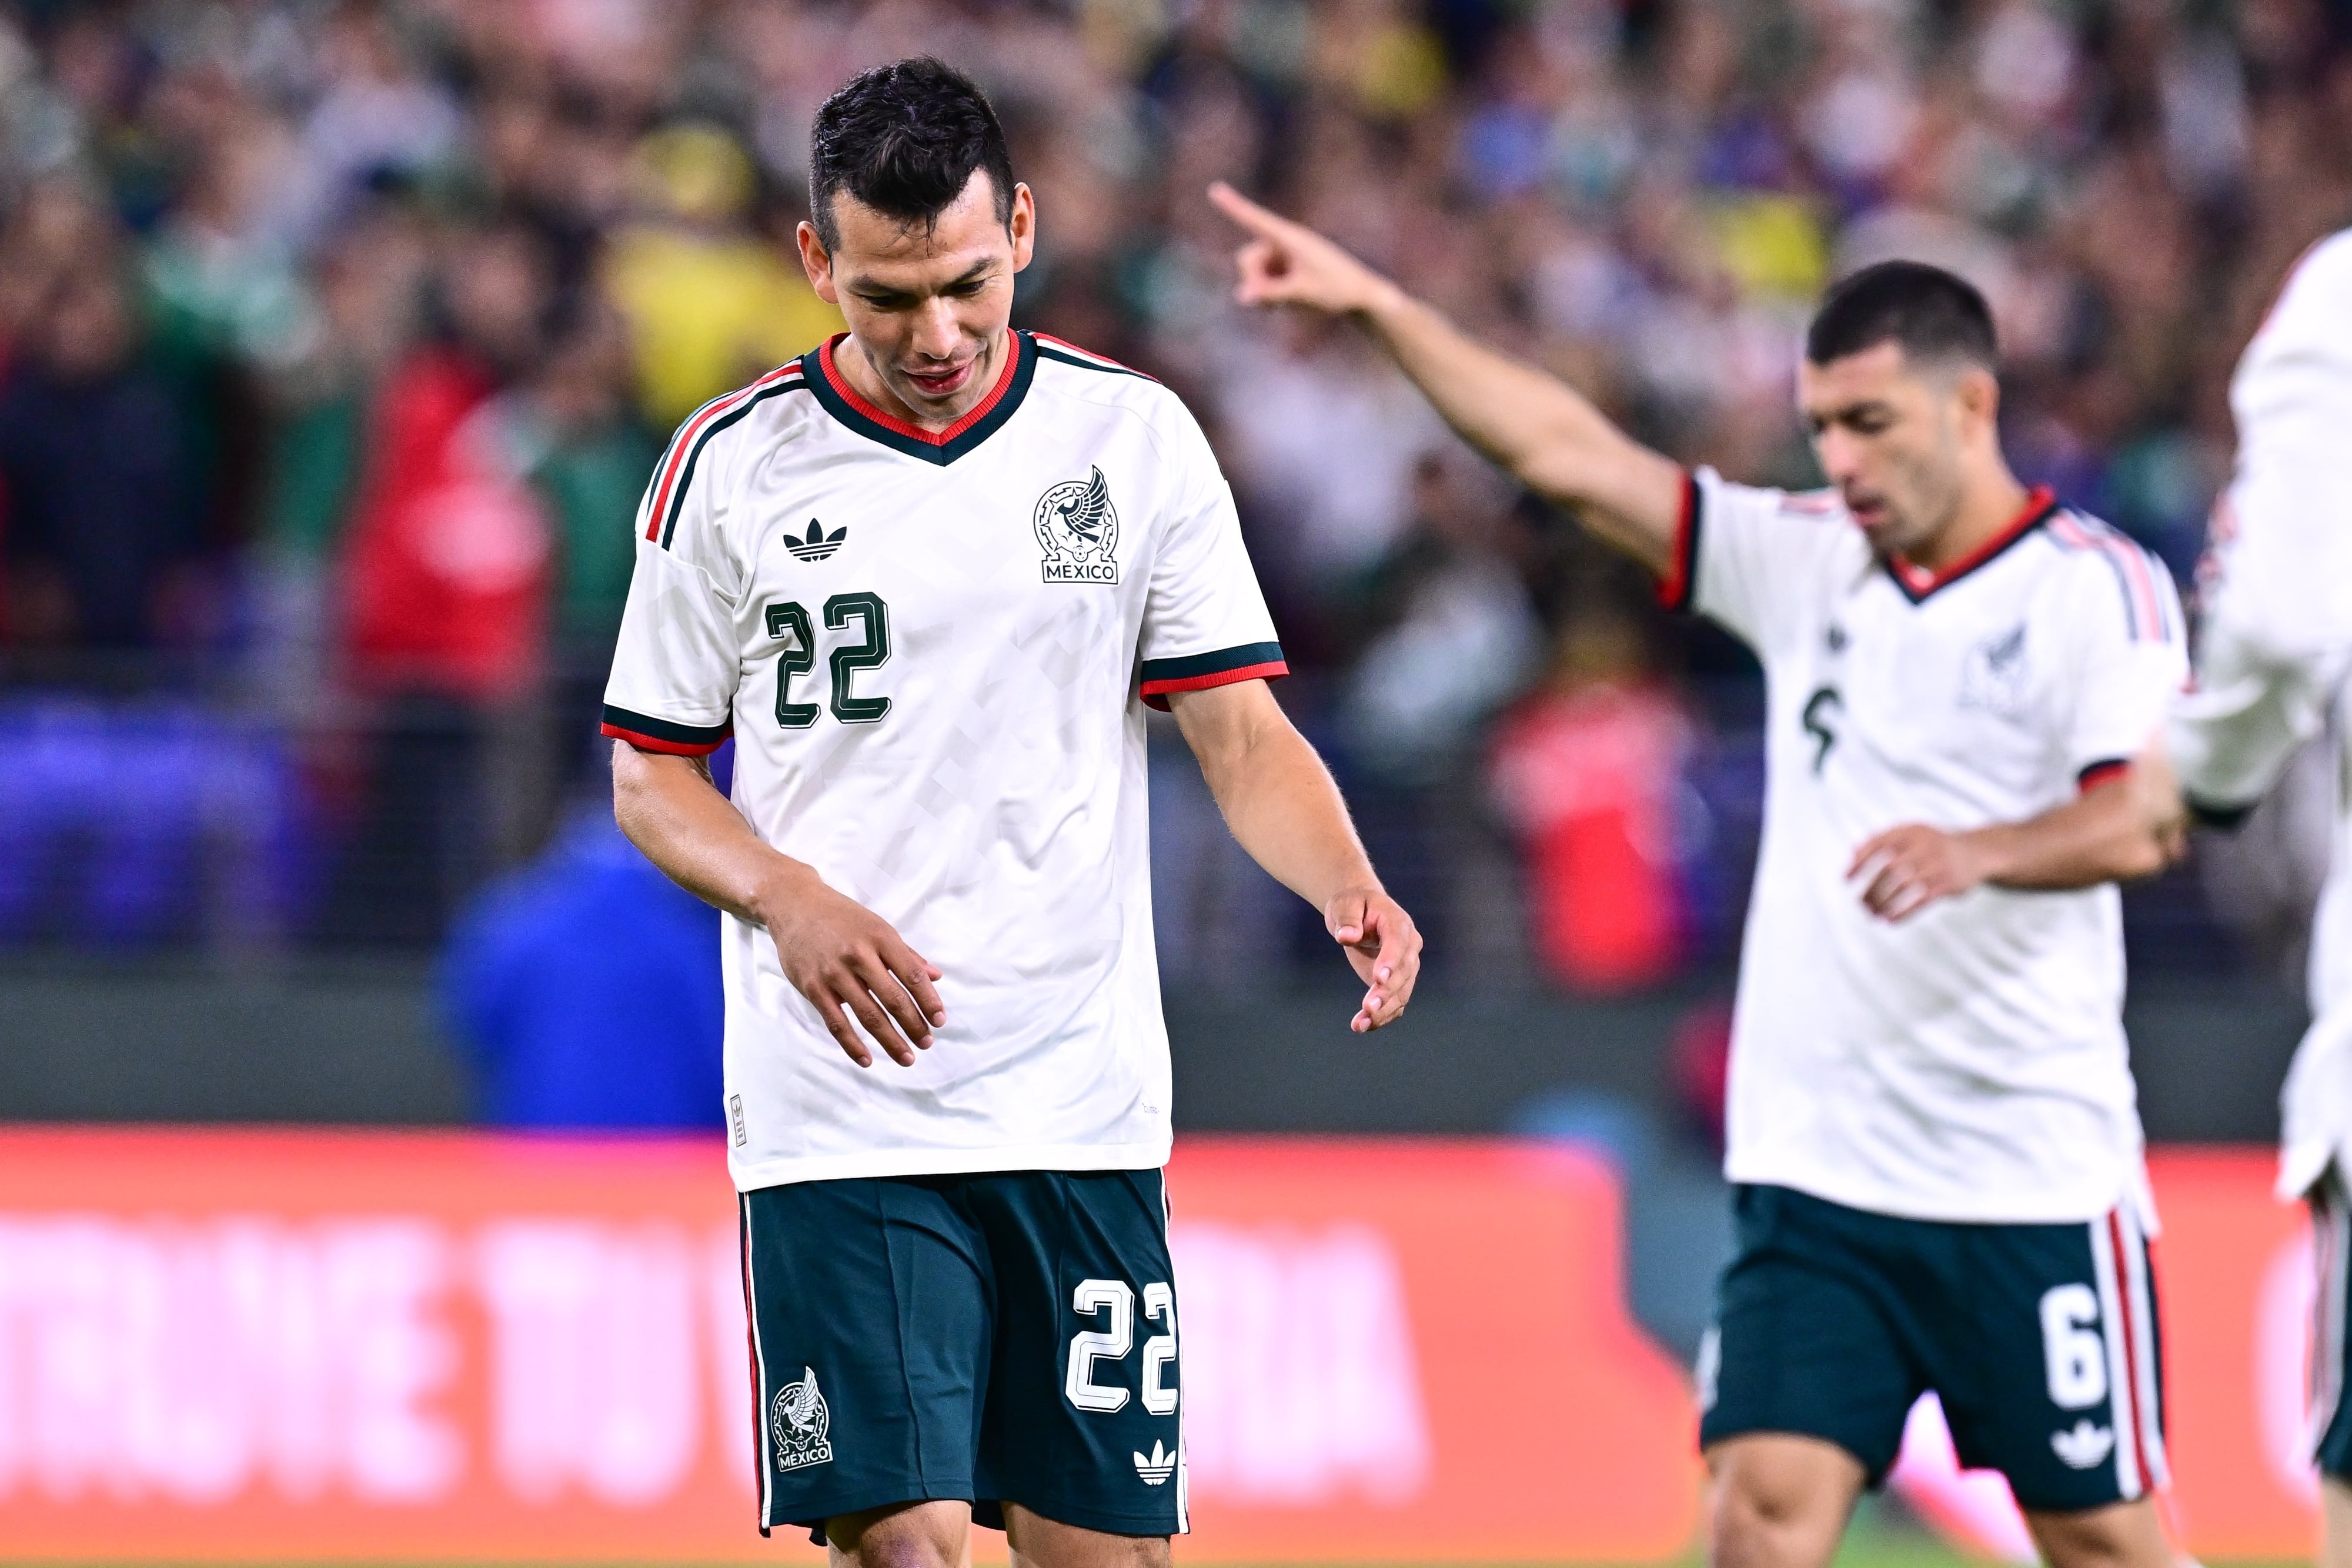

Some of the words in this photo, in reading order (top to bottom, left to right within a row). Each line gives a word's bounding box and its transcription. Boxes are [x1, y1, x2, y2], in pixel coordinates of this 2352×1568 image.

[1047, 561, 1114, 579] MÉXICO
[765, 591, 891, 729] 22
[1065, 1279, 1178, 1416] 22
[2039, 1282, 2107, 1411] 6
[780, 1447, 828, 1469] MÉXICO
